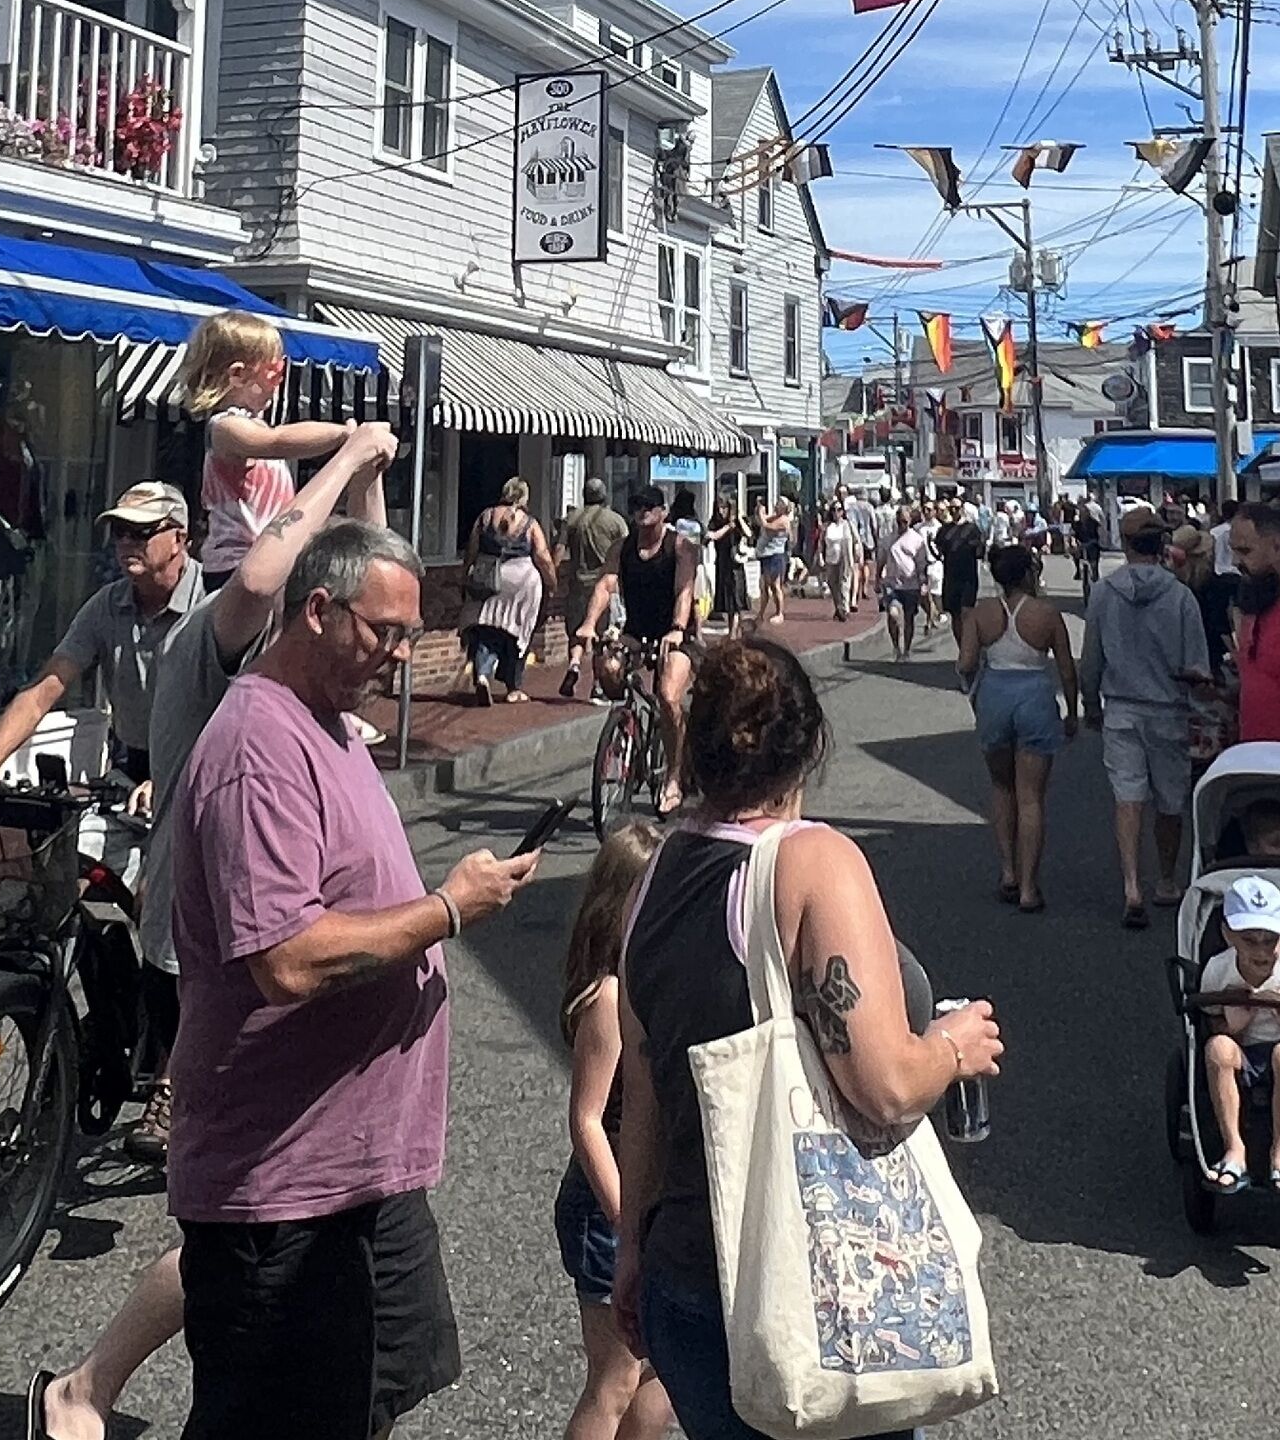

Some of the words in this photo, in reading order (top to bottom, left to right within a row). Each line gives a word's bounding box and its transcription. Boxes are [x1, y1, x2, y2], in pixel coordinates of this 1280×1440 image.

[520, 117, 598, 144] MAYFLOWER
[520, 206, 548, 226] FOOD
[560, 203, 595, 226] DRINK
